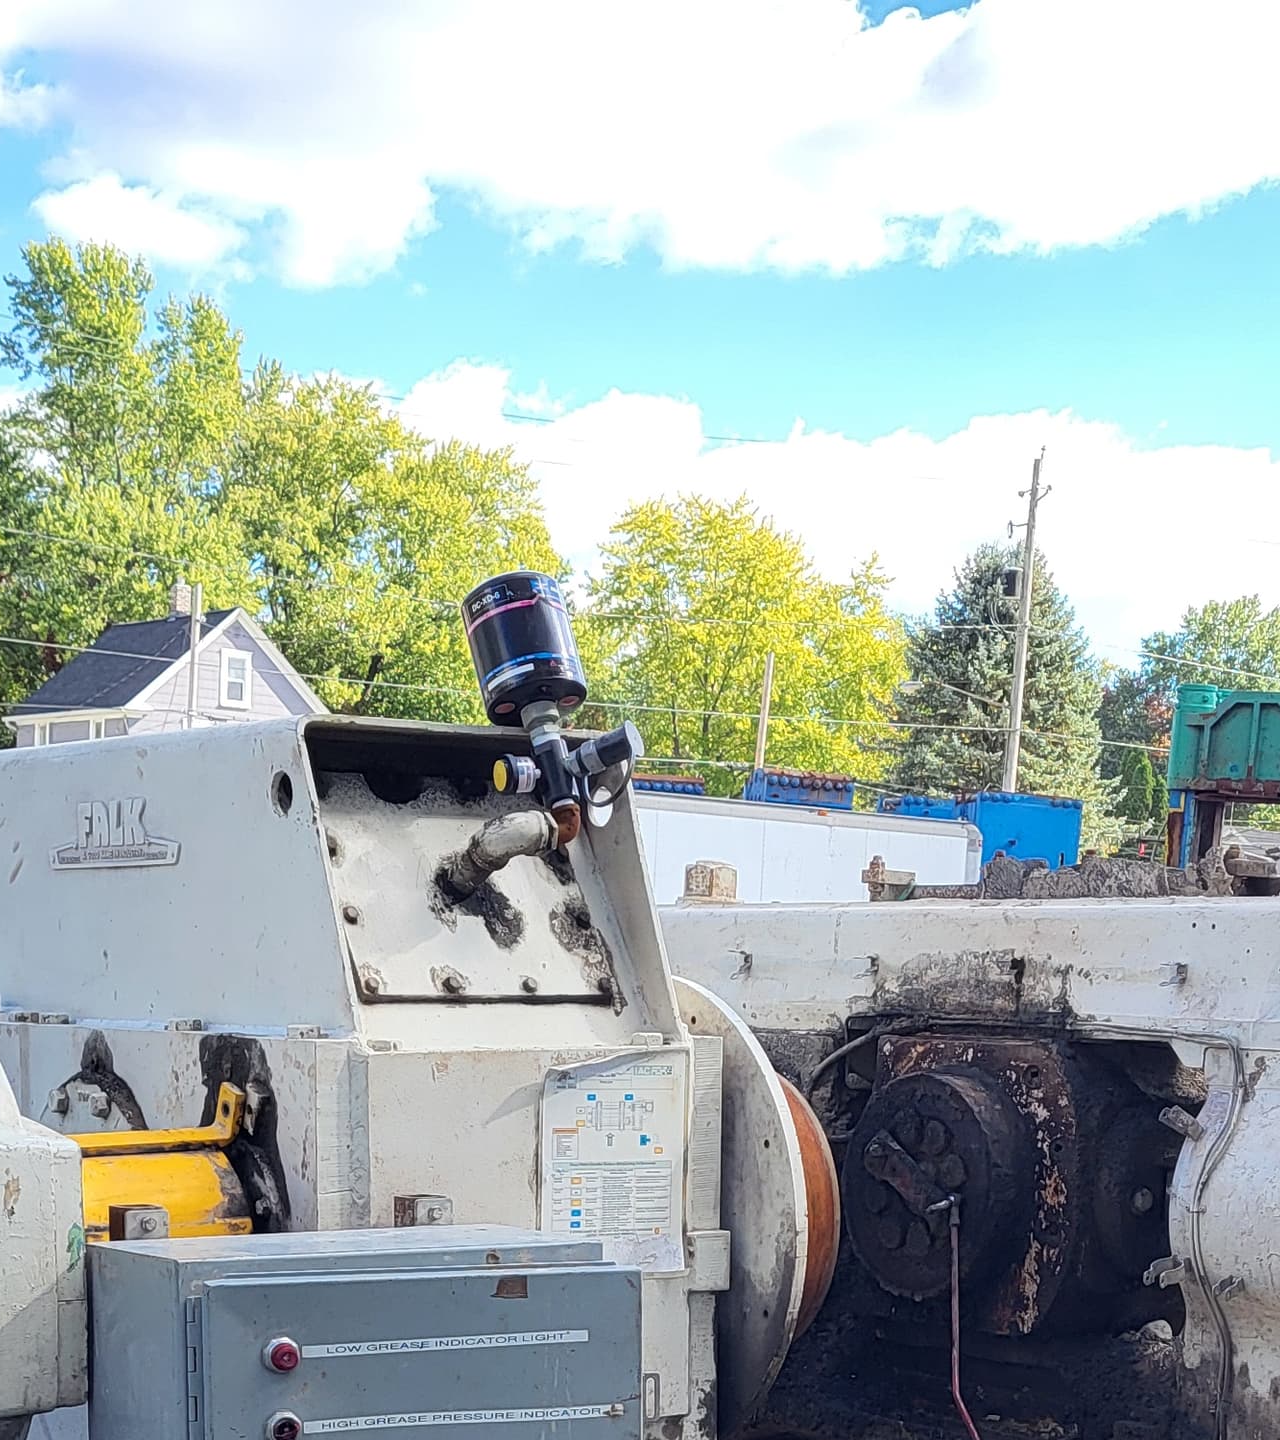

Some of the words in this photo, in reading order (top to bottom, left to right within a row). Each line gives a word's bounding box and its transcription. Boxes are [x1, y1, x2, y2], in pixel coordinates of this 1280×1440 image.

[77, 797, 146, 848] FALK
[326, 1344, 362, 1354] LOW
[366, 1341, 428, 1352] GREASE
[435, 1336, 518, 1348] INDICATOR
[522, 1333, 565, 1342] LIGHT
[322, 1419, 360, 1430] HIGH
[364, 1414, 426, 1426] GREASE
[432, 1411, 514, 1422] PRESSURE
[520, 1407, 602, 1419] INDICATOR
